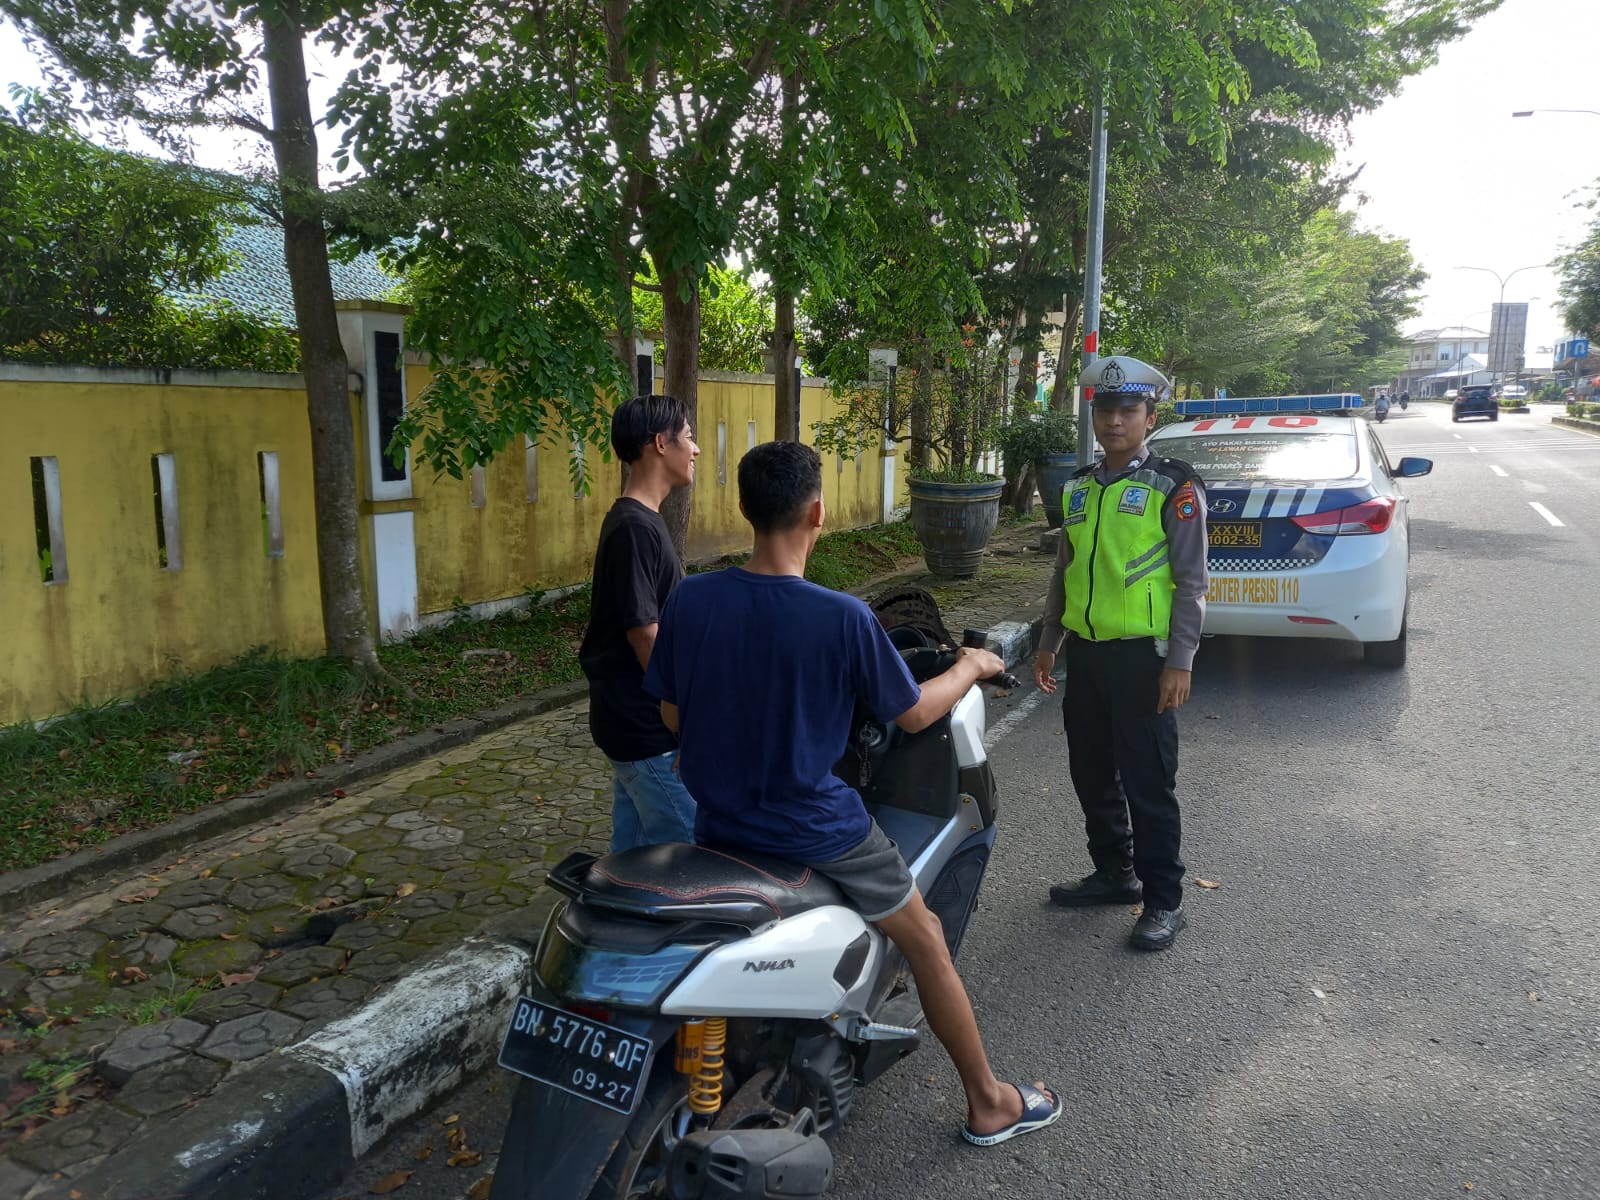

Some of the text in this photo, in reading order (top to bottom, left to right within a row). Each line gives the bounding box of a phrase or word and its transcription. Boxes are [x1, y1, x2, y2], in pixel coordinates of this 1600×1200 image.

[1192, 416, 1318, 431] 110
[1212, 524, 1255, 536] XXVIII
[1242, 576, 1279, 604] PRESISI
[1281, 576, 1300, 604] 110
[514, 1003, 543, 1036] BN
[549, 1015, 607, 1059] 5776
